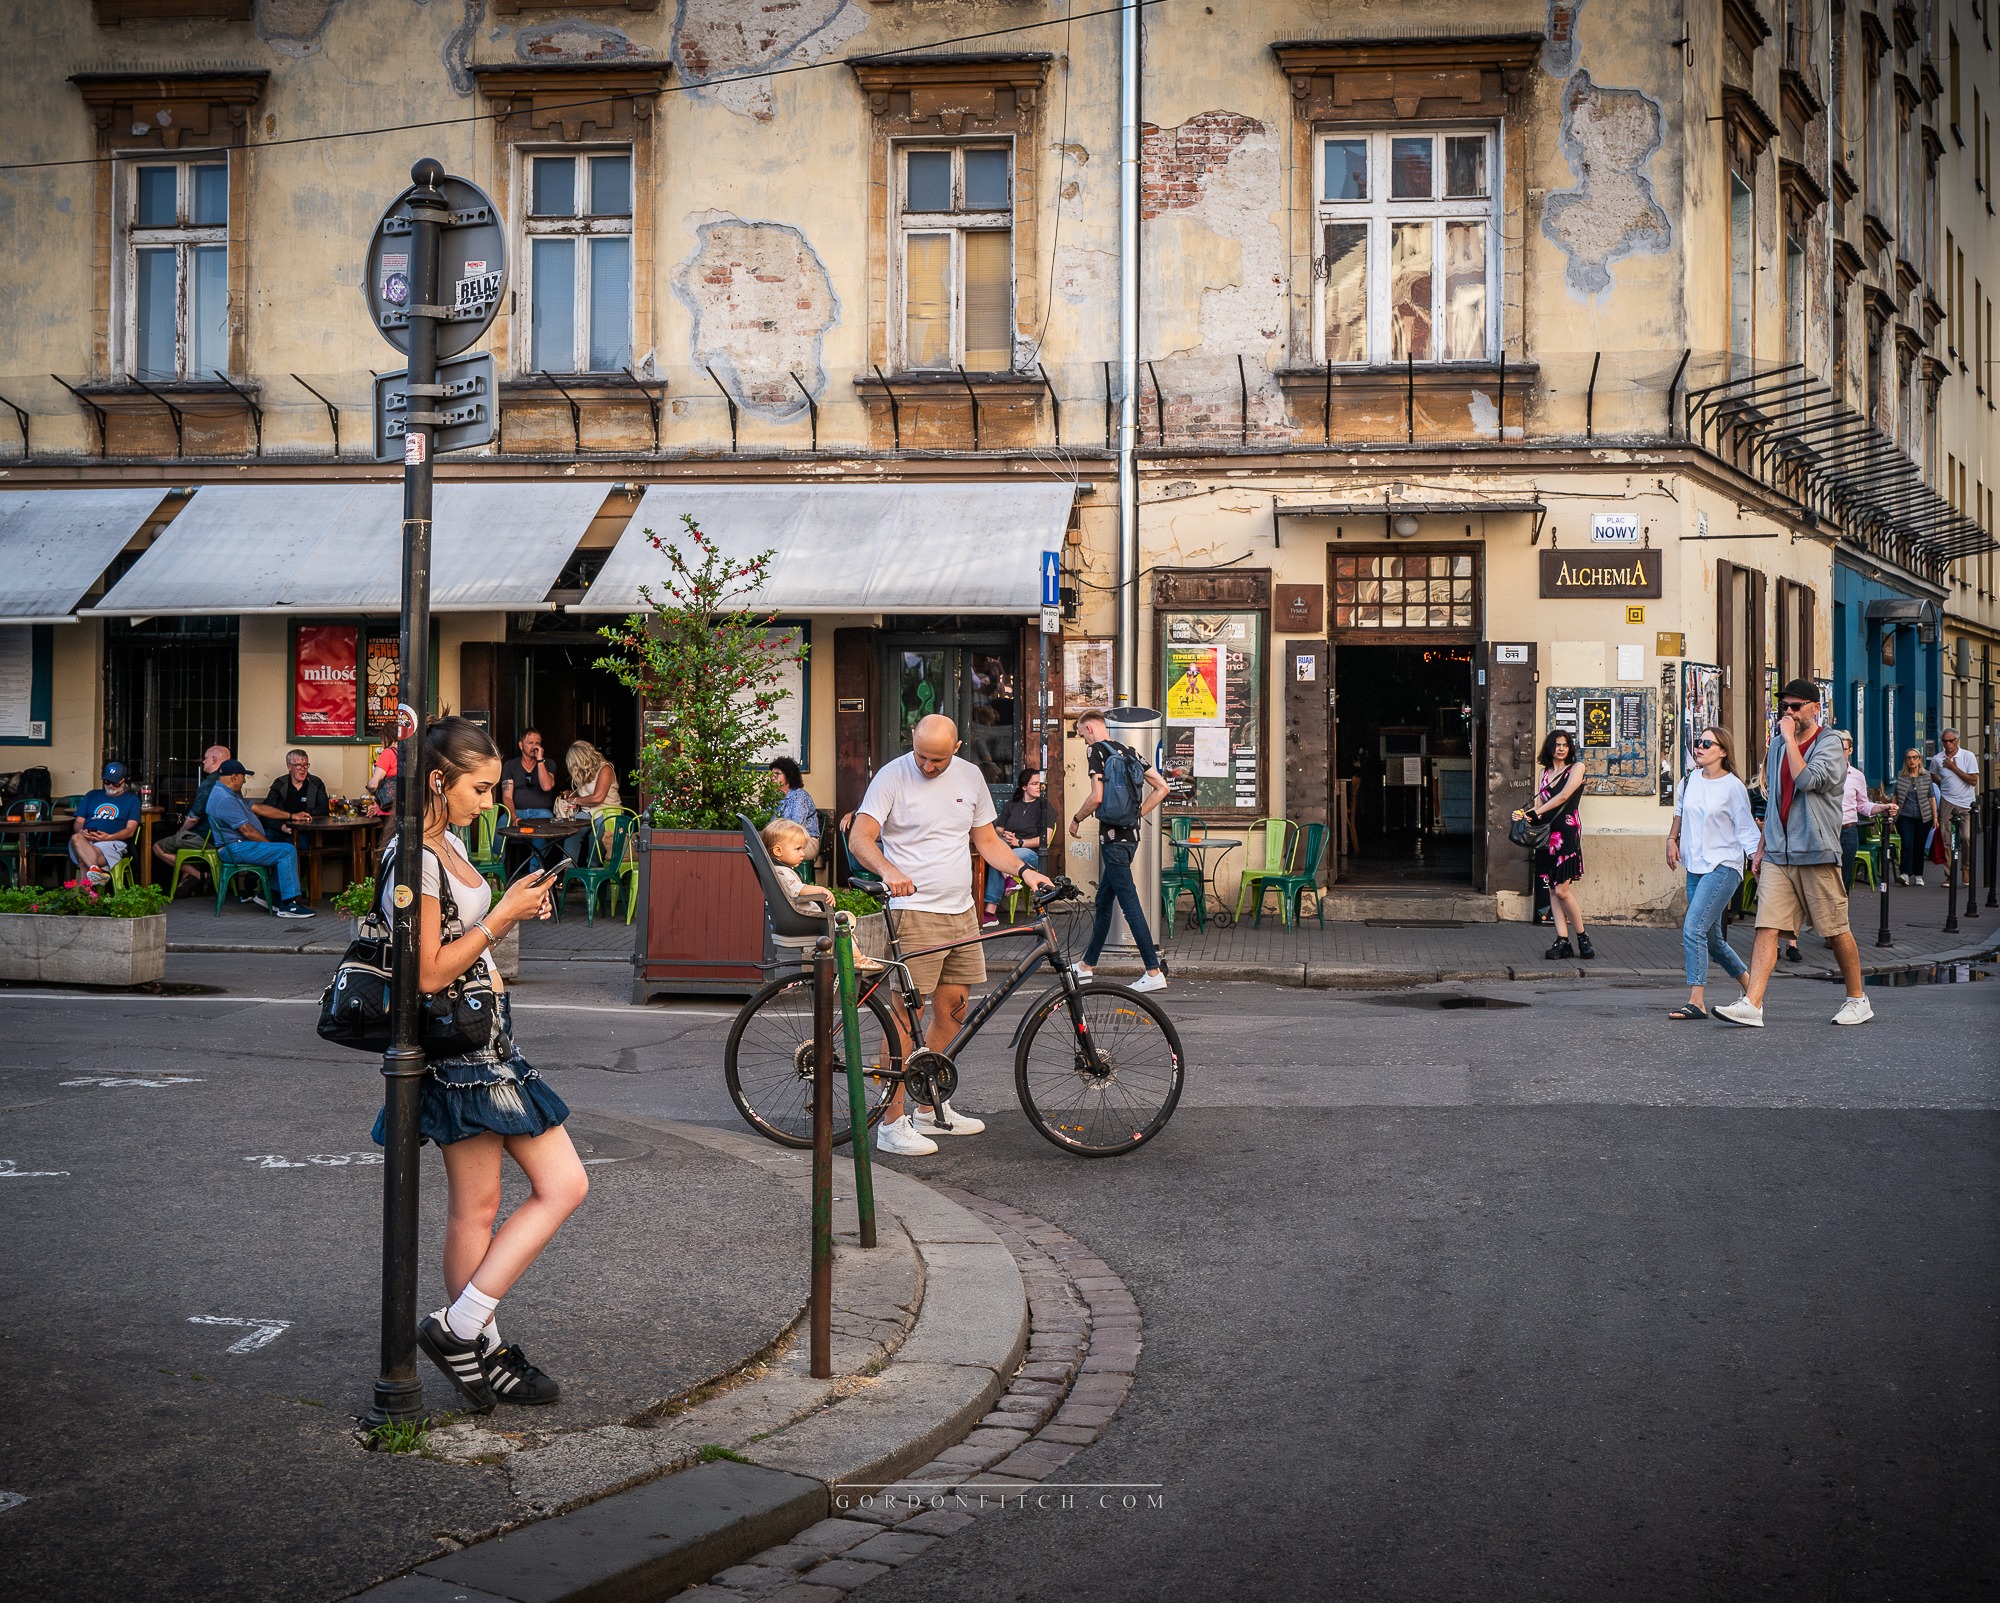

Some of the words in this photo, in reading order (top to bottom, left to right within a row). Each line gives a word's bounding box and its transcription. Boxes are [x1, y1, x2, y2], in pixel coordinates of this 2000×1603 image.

[1595, 526, 1636, 539] NOWY
[1173, 622, 1190, 631] HAPPY
[1197, 623, 1216, 640] 14
[1173, 630, 1190, 639] HOURS
[368, 643, 399, 657] PEACE
[382, 697, 399, 710] AND
